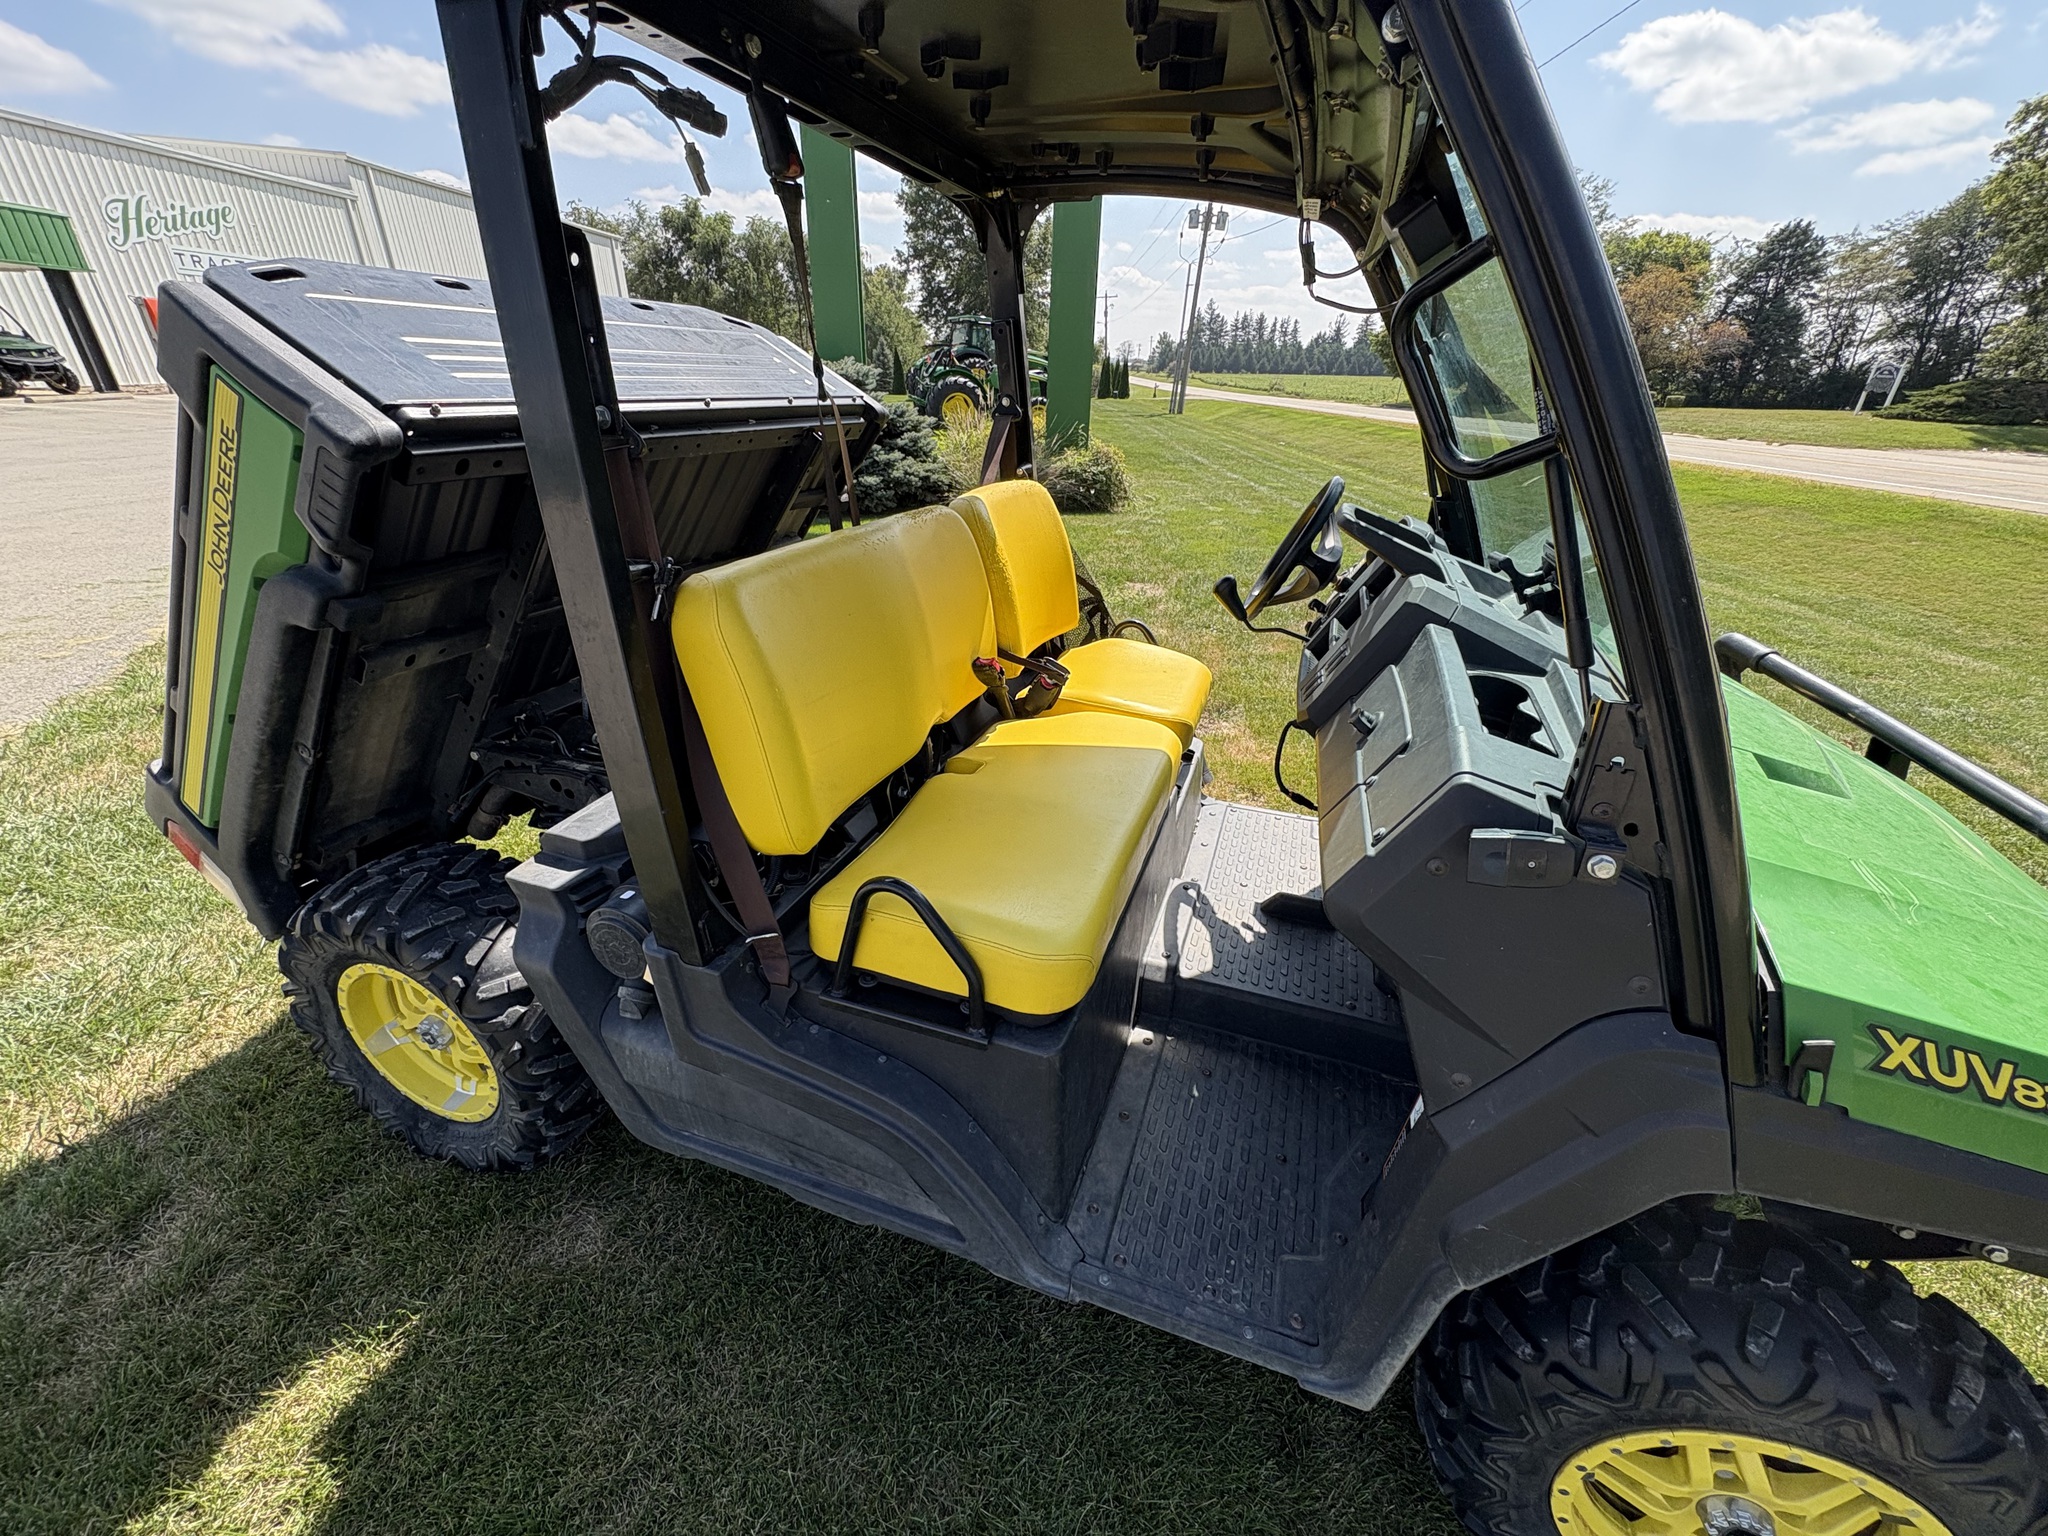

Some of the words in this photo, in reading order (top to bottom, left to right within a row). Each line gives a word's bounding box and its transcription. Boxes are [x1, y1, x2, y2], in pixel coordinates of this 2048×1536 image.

[105, 194, 234, 247] Heritage
[173, 252, 245, 269] TRAC
[212, 418, 237, 514] DEERE
[207, 514, 231, 586] JOHN
[1873, 1026, 2048, 1110] XUV8
